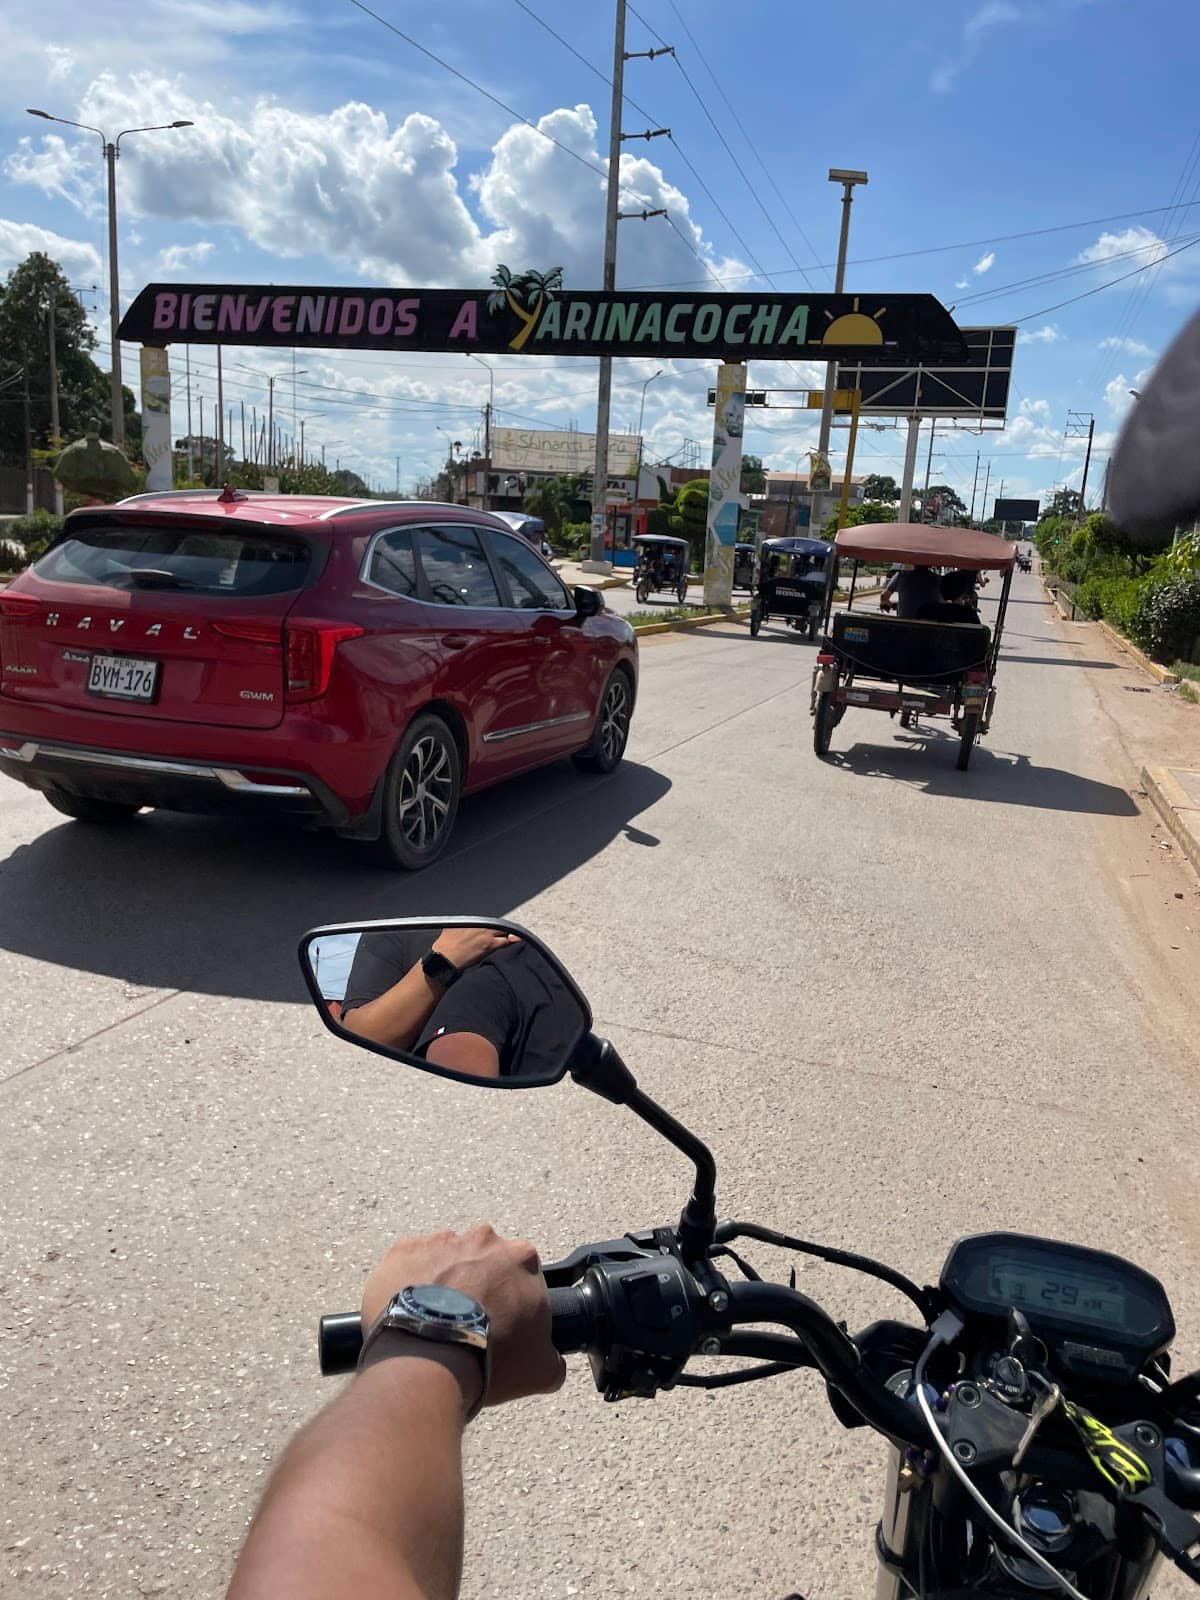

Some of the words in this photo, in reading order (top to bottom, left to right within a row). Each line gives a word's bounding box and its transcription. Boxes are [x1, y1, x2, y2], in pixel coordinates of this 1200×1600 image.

[153, 291, 421, 337] BIENVENIDOS
[448, 300, 478, 340] A
[91, 664, 152, 693] BYM-176
[239, 690, 275, 702] GWM
[1040, 1279, 1080, 1306] 29
